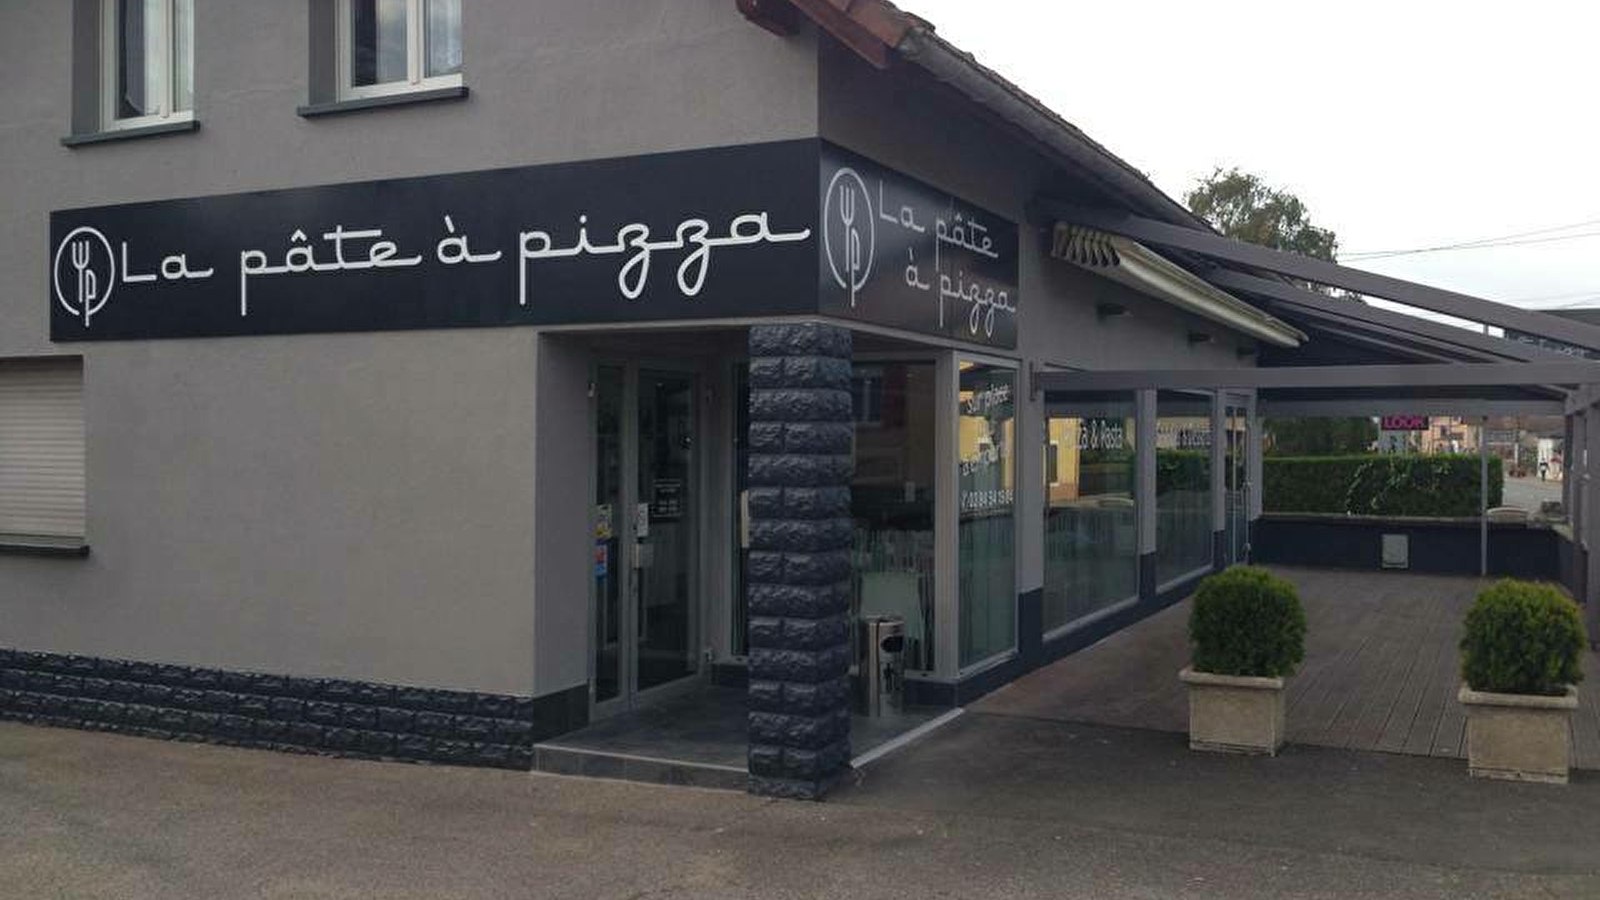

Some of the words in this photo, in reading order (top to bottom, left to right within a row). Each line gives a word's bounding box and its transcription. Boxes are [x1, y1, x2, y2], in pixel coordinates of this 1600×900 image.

[122, 241, 214, 283] La
[240, 224, 423, 317] pâte
[436, 214, 502, 264] à
[519, 211, 811, 306] pizza
[878, 180, 925, 233] La
[935, 213, 999, 272] pâte
[905, 247, 931, 291] à
[939, 270, 1017, 338] pizza
